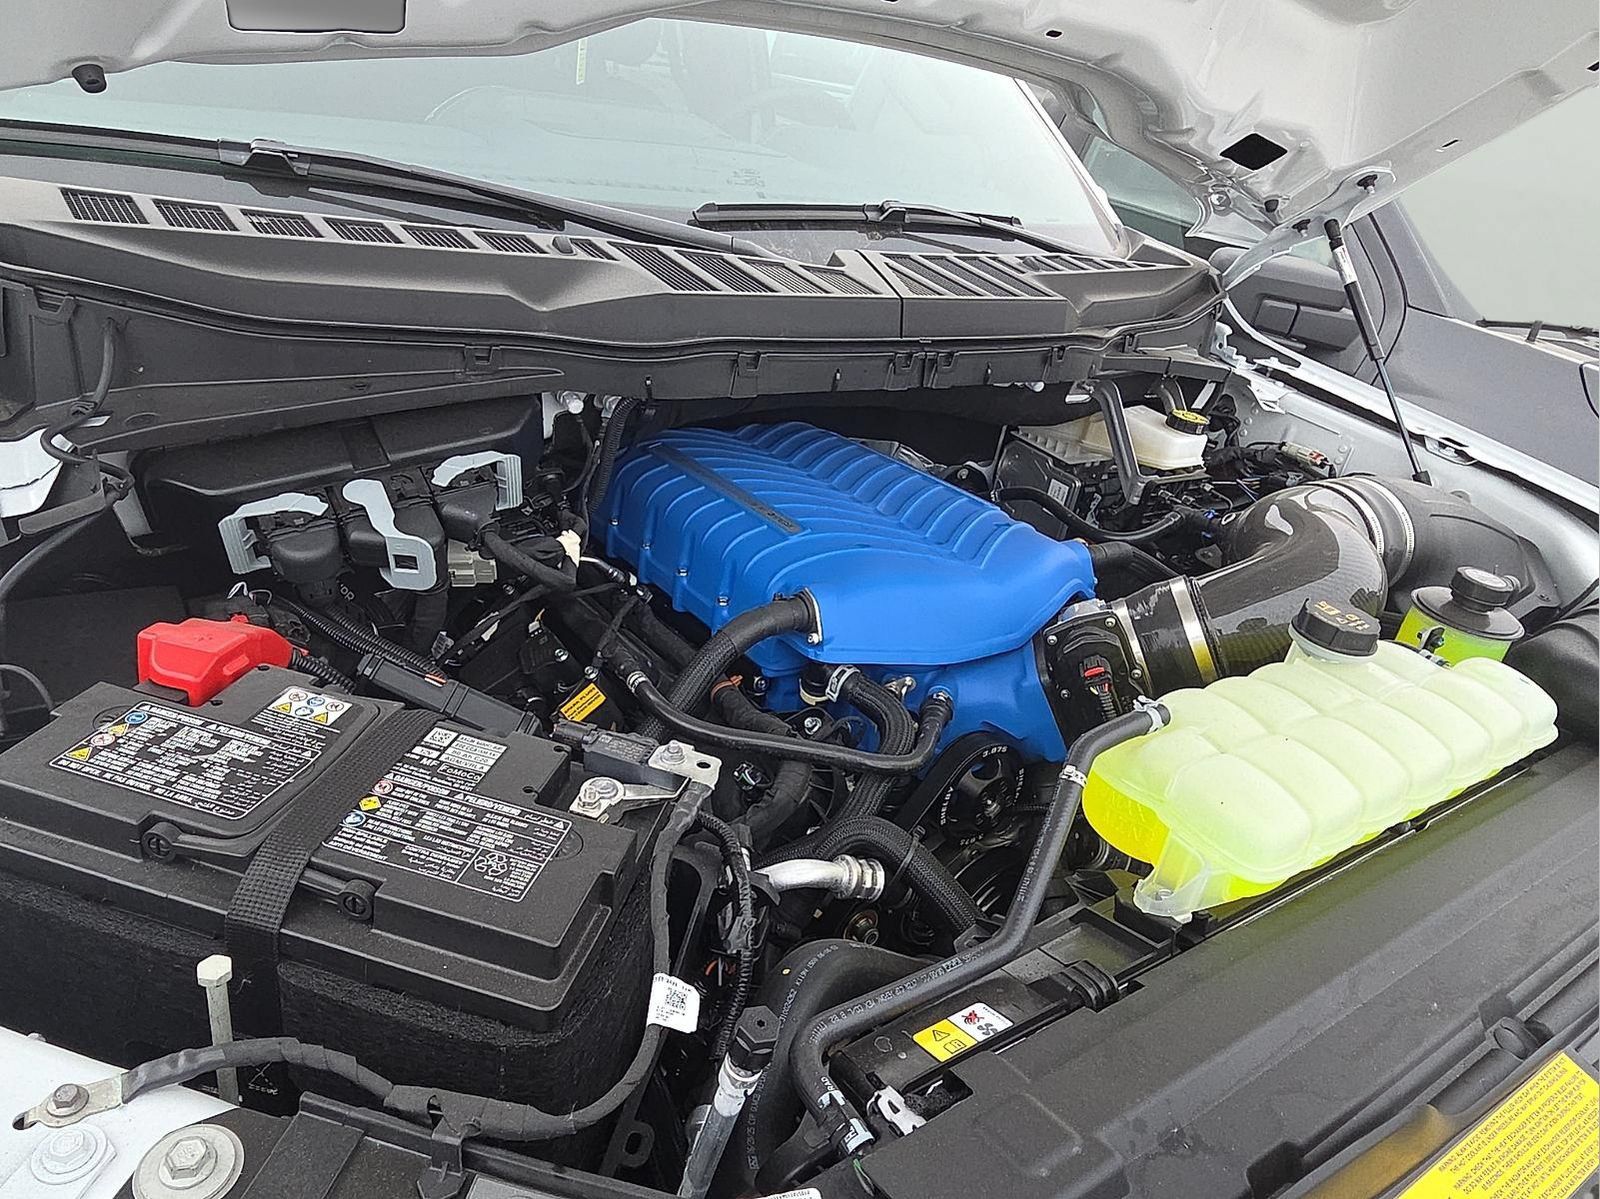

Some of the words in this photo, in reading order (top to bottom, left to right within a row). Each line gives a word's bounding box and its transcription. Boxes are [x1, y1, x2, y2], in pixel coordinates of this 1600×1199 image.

[418, 757, 440, 767] MF
[439, 764, 482, 780] FoMoCo
[940, 786, 954, 826] SHELBY
